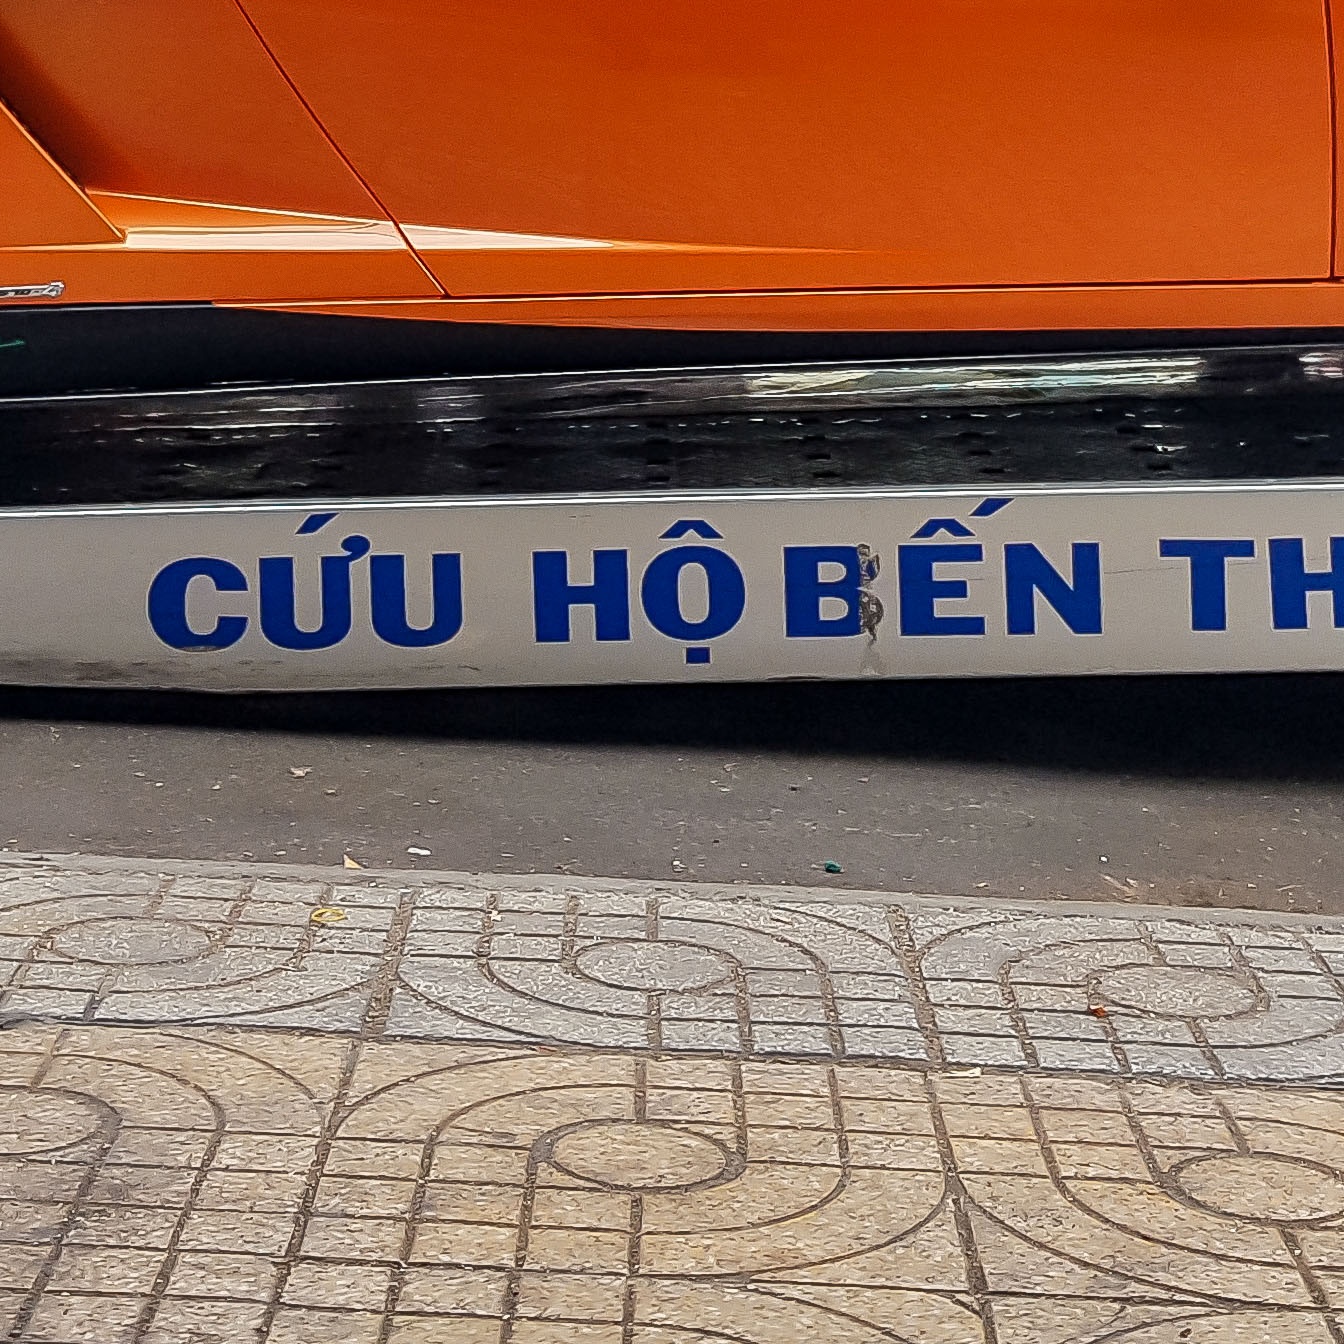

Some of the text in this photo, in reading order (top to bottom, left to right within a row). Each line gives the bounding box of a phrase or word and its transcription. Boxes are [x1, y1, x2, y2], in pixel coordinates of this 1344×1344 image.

[146, 513, 464, 652] CỨU
[532, 520, 747, 665] HỘ
[784, 498, 1104, 639] BẾN
